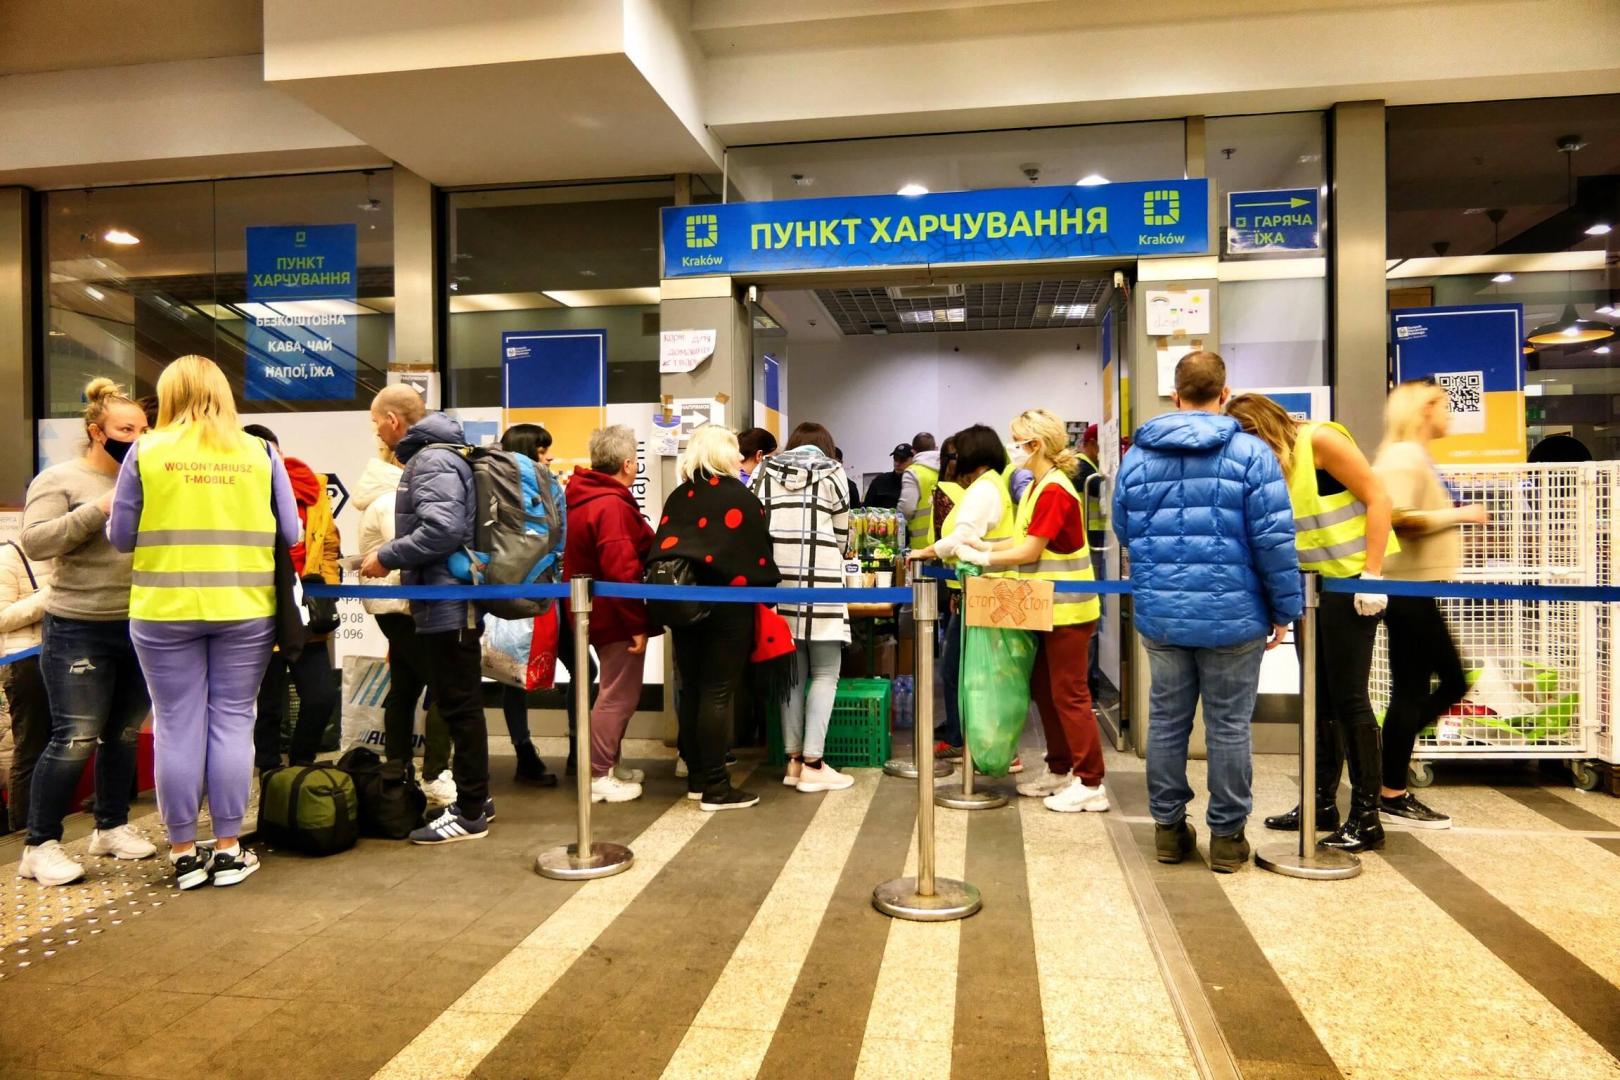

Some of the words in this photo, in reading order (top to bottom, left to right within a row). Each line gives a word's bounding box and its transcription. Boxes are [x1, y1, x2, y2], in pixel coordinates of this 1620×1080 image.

[751, 218, 862, 250] ПУНКТ
[869, 206, 1108, 244] ХАРЧУВАННЯ
[1254, 214, 1313, 228] ГАРЯЧА
[1138, 233, 1185, 245] Kraków
[1254, 230, 1285, 245] ЇЖА
[276, 256, 325, 270] ПУНКТ
[682, 255, 723, 267] Kraków
[253, 272, 351, 287] ХАРЧУВАННЯ
[256, 314, 346, 327] БЕЗКОШТОВНА
[267, 340, 305, 353] КАВА,
[307, 337, 333, 352] ЧАЙ
[265, 363, 308, 379] НАПОЇ,
[310, 363, 335, 378] ЇЖА
[164, 462, 253, 473] WOLONTARIUSZ
[184, 474, 236, 485] T-MOBILE
[632, 441, 651, 521] najem
[968, 595, 996, 608] СТОП
[343, 629, 364, 639] 096
